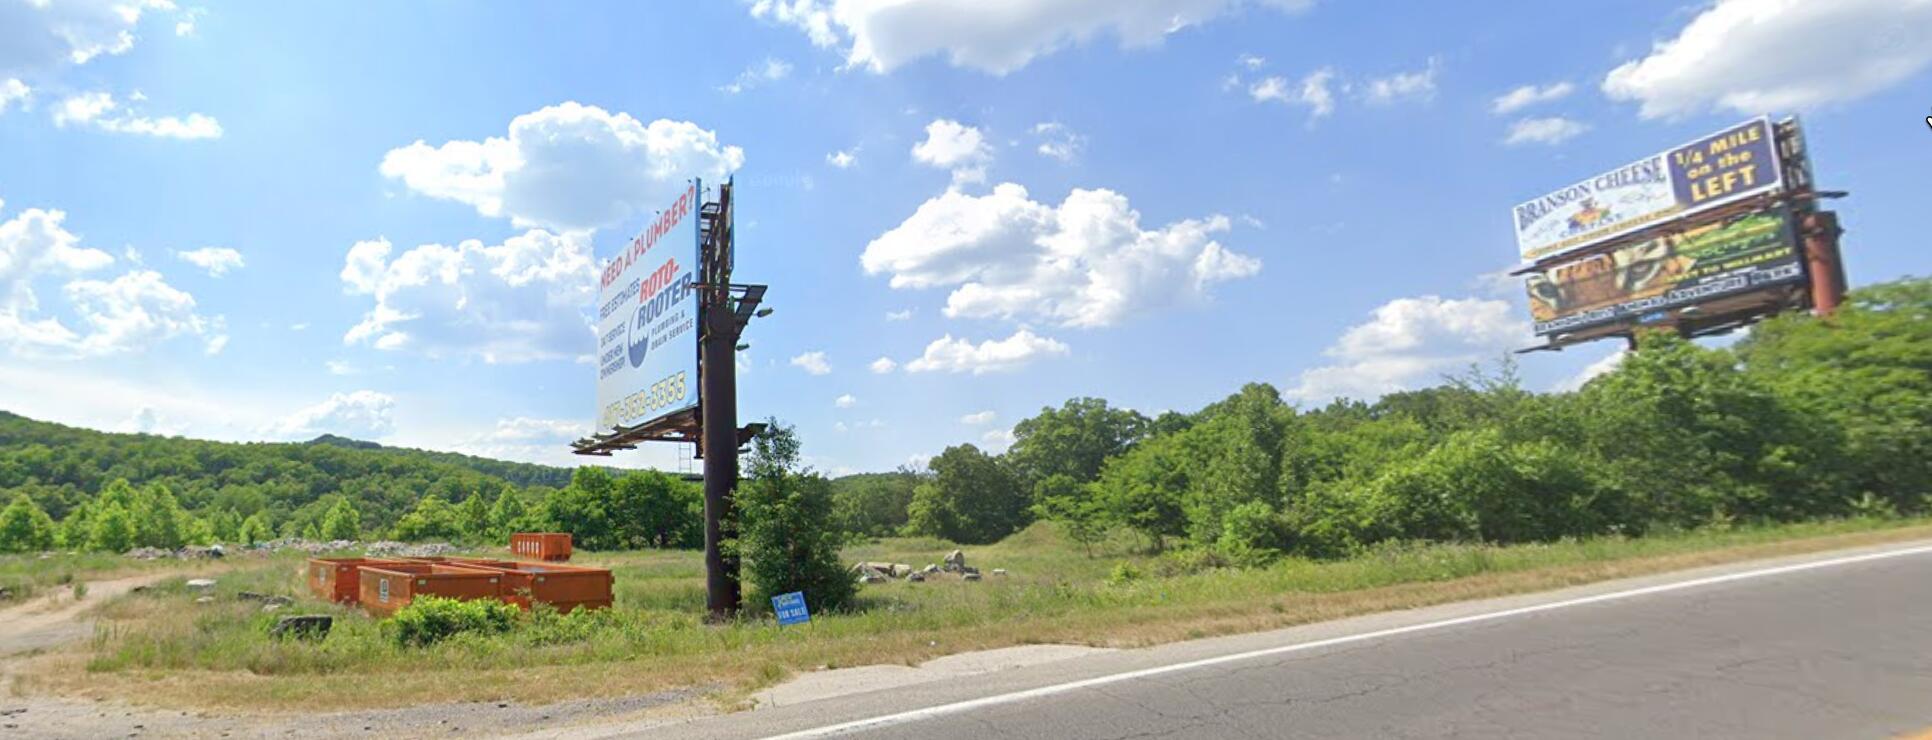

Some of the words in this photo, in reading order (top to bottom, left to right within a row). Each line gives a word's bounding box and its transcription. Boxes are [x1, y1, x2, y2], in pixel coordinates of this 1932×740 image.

[1674, 150, 1703, 168] 1/4
[1709, 127, 1761, 154] MILE
[1687, 164, 1712, 179] on
[1717, 152, 1752, 168] the
[1516, 180, 1592, 231] BRANSON
[1594, 156, 1667, 190] CHEESE
[1690, 165, 1757, 202] LEFT
[600, 256, 622, 293] NEED
[625, 248, 632, 271] A
[634, 185, 695, 262] PLUMBER?
[637, 271, 692, 330] ROOTER
[639, 257, 680, 304] ROTO-
[669, 318, 693, 340] SERVICE
